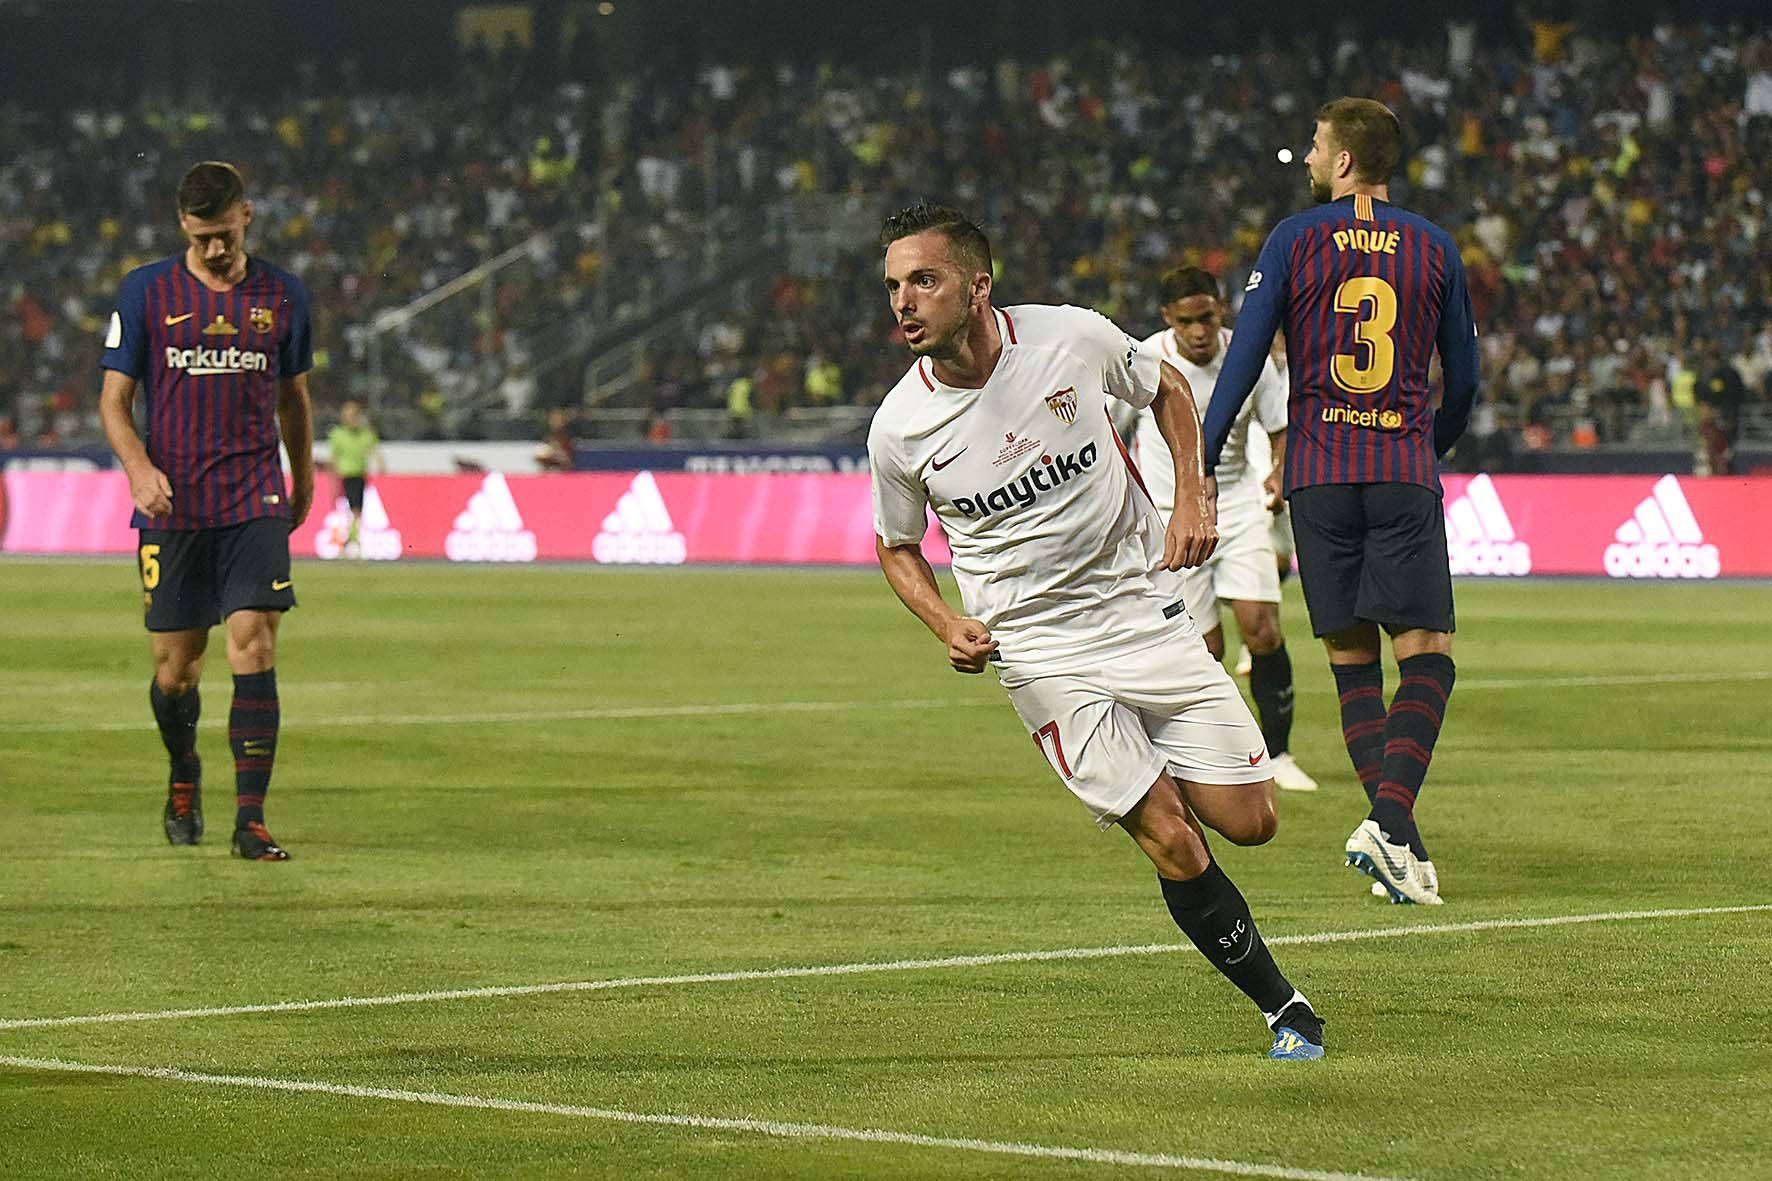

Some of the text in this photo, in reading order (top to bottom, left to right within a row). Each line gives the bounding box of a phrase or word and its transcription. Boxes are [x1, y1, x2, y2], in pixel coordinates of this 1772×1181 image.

[1332, 229, 1401, 255] PIQUÉ
[1330, 276, 1398, 394] 3
[165, 345, 268, 375] Rakuten
[1321, 404, 1379, 428] unicef
[1448, 541, 1532, 575] didas
[1218, 919, 1246, 949] SFC
